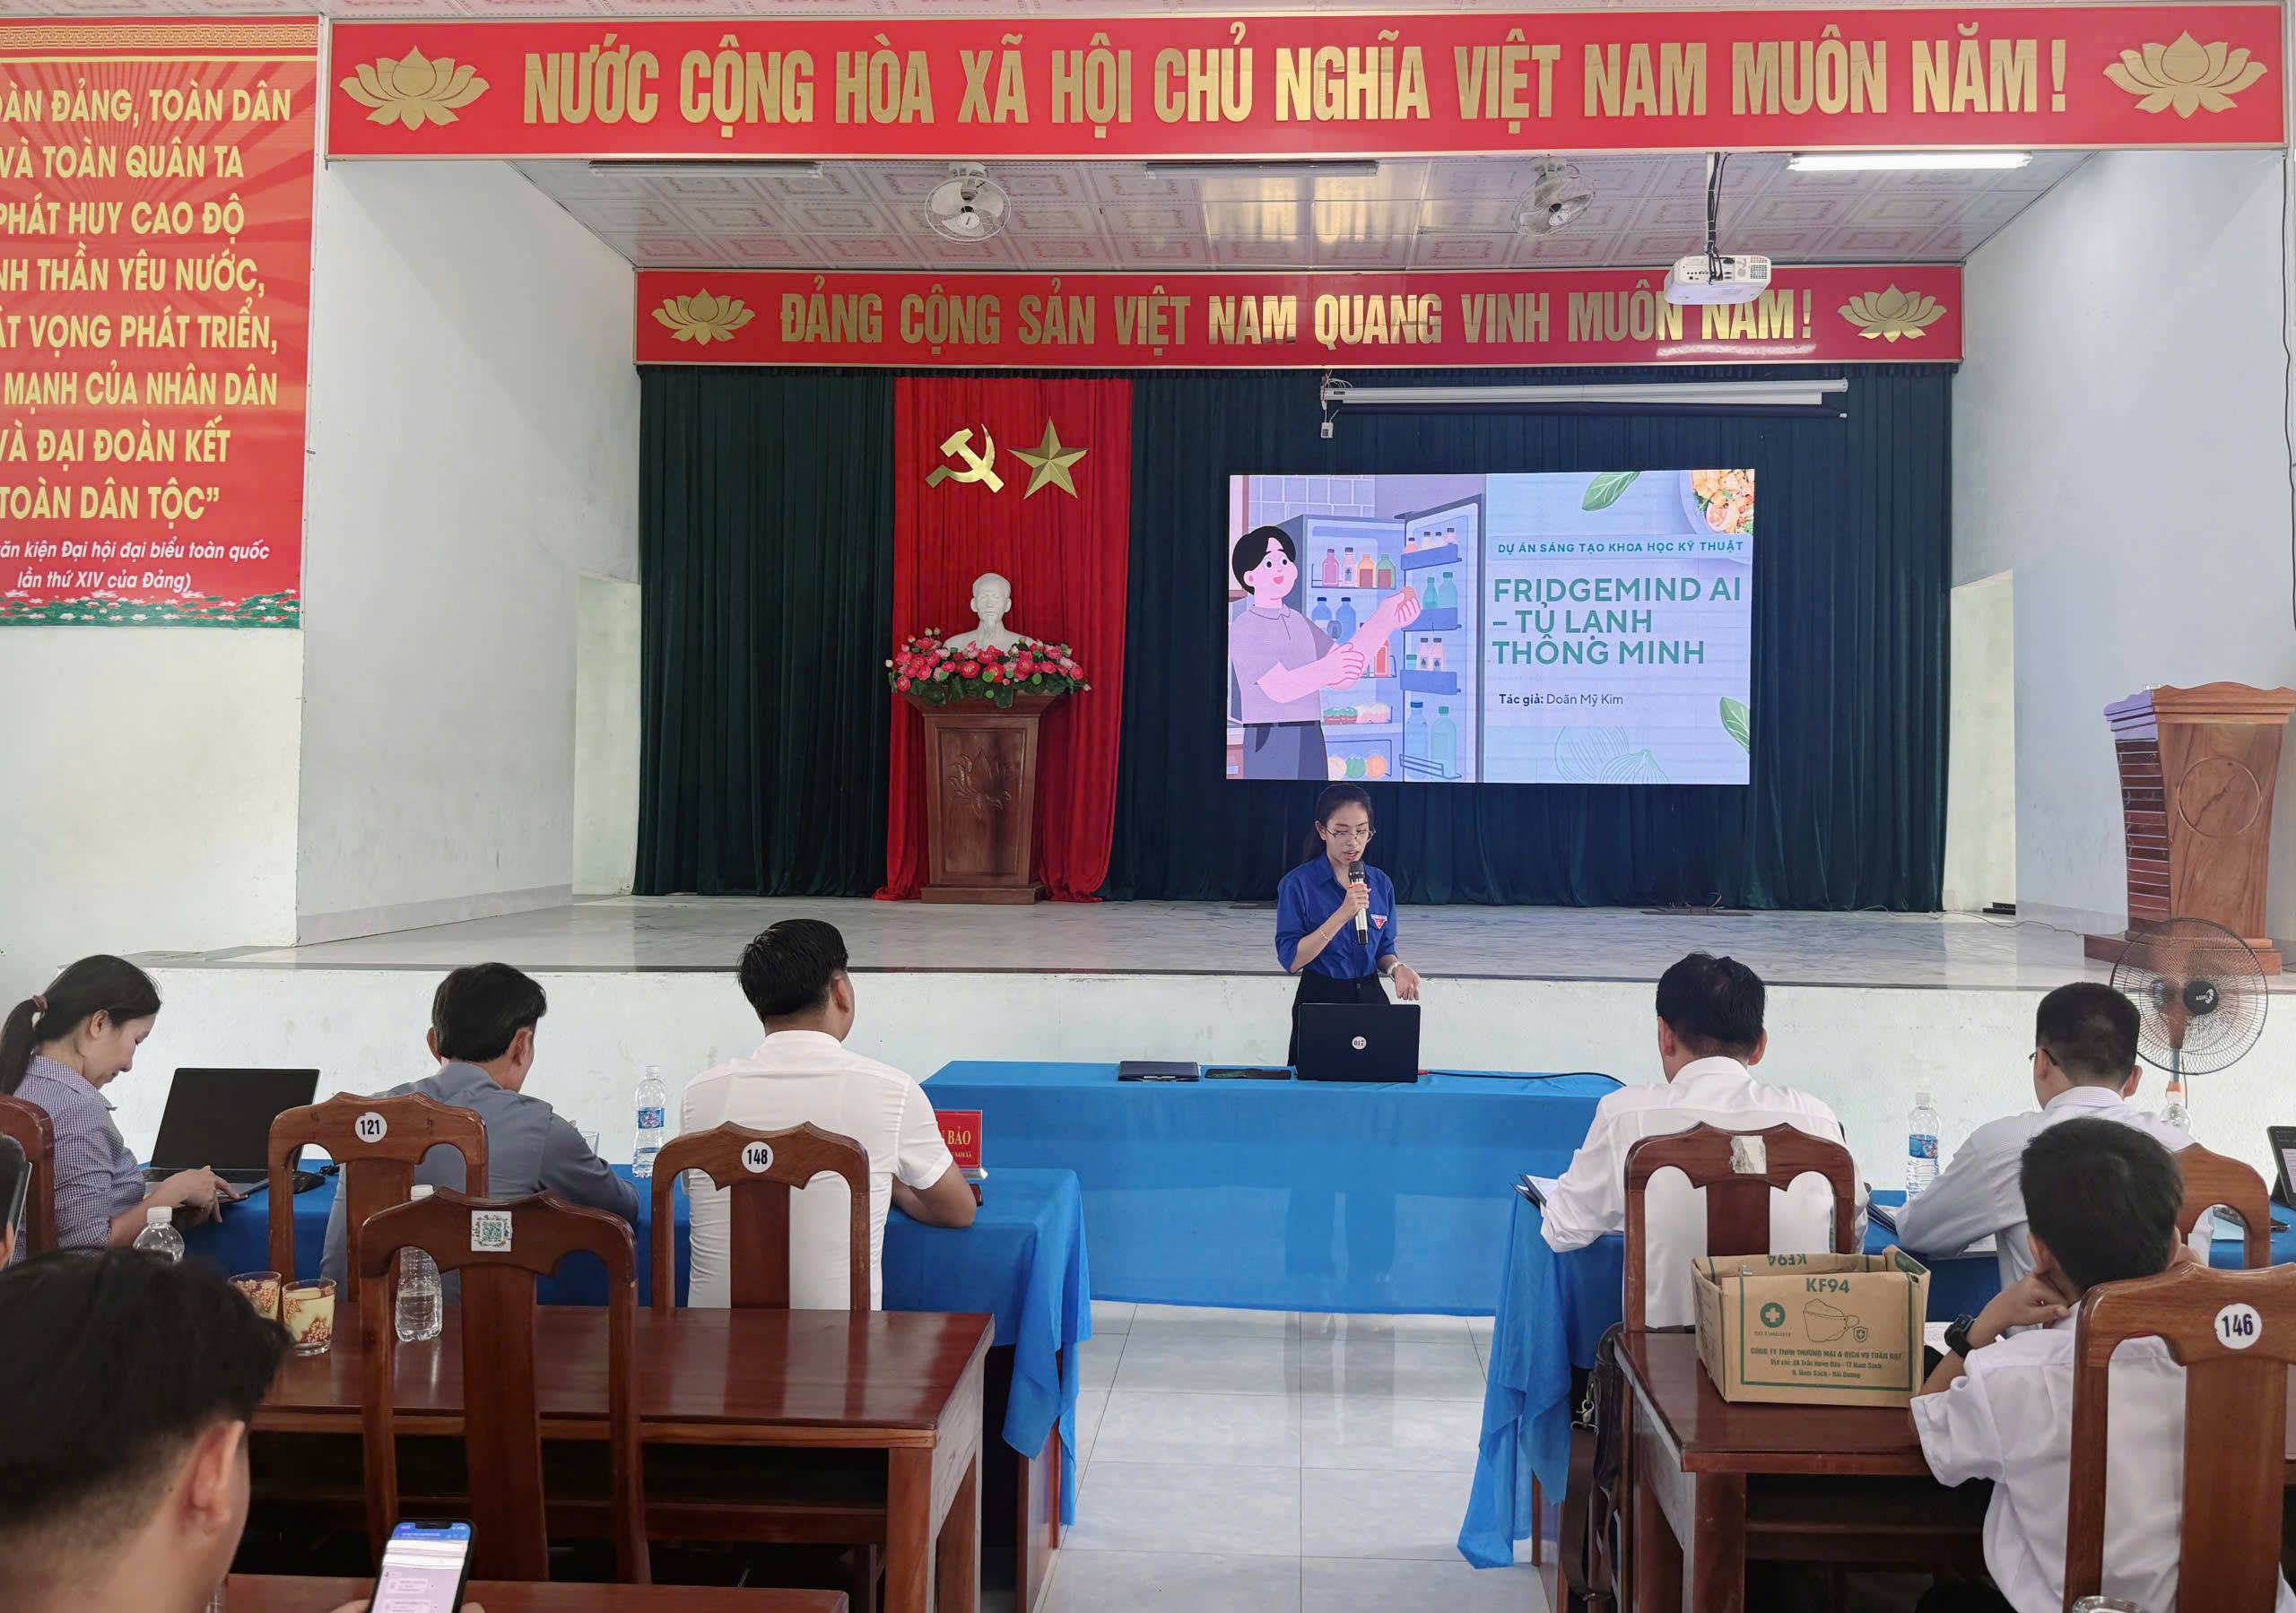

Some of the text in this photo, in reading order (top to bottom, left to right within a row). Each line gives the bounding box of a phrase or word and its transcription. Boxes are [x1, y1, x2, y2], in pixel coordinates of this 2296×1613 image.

[524, 34, 658, 123] NƯỚC
[681, 35, 813, 137] CỘNG
[836, 34, 934, 123] HÒA
[959, 34, 1029, 122] XÃ
[1052, 32, 1131, 138] HỘI
[1154, 22, 1253, 123] CHỦ
[1276, 30, 1430, 121] NGHĨA
[1455, 29, 1561, 134] VIỆT
[1585, 43, 1707, 116] NAM
[1733, 25, 1887, 115] MUÔN
[0, 79, 291, 129] ÀN ĐẢNG, TOÀN DÂN
[0, 135, 244, 179] VÀ TOÀN QUÂN TA
[67, 201, 122, 234] HUY
[131, 201, 194, 234] CAO
[202, 193, 245, 244] ĐỘ
[37, 242, 109, 291] THẦN
[118, 248, 166, 291] YÊU
[176, 249, 264, 299] NƯỚC,
[29, 316, 111, 358] VỌNG
[119, 306, 191, 348] PHÁT
[196, 297, 276, 353] TRIỂN,
[781, 277, 882, 343] ĐẢNG
[900, 285, 999, 354] CỘNG
[1019, 279, 1095, 344] SẢN
[1115, 285, 1190, 355] VIỆT
[1209, 295, 1299, 344] NAM
[1314, 293, 1441, 350] QUANG
[1463, 294, 1549, 343] VINH
[1569, 279, 1683, 342] MUÔN
[4, 360, 277, 414] MẠNH CỦA NHÂN DÂN
[37, 429, 84, 471] ĐẠI
[93, 420, 175, 462] ĐOÀN
[186, 416, 230, 463] KẾT
[0, 477, 219, 529] TOÀN DÂN TỘC”
[0, 536, 269, 562] ăn kiện Đại hội đại biểu toàn quốc
[1498, 539, 1744, 555] DỰ ÁN SÁNG TẠO KHOA HỌC KỸ THUẬT
[18, 567, 192, 594] lần thứ XIV của Đảng)
[1494, 577, 1741, 603] FRIDGEMIND AI
[1515, 602, 1555, 633] TỦ
[1566, 609, 1652, 640] LẠNH
[1492, 634, 1704, 664] THÔNG MINH
[1499, 693, 1623, 707] Tác giả: Doãn Mỹ Kim
[361, 1119, 380, 1135] 121
[747, 1149, 768, 1165] 148
[1806, 1278, 1849, 1293] KF94
[2222, 1314, 2254, 1338] 146
